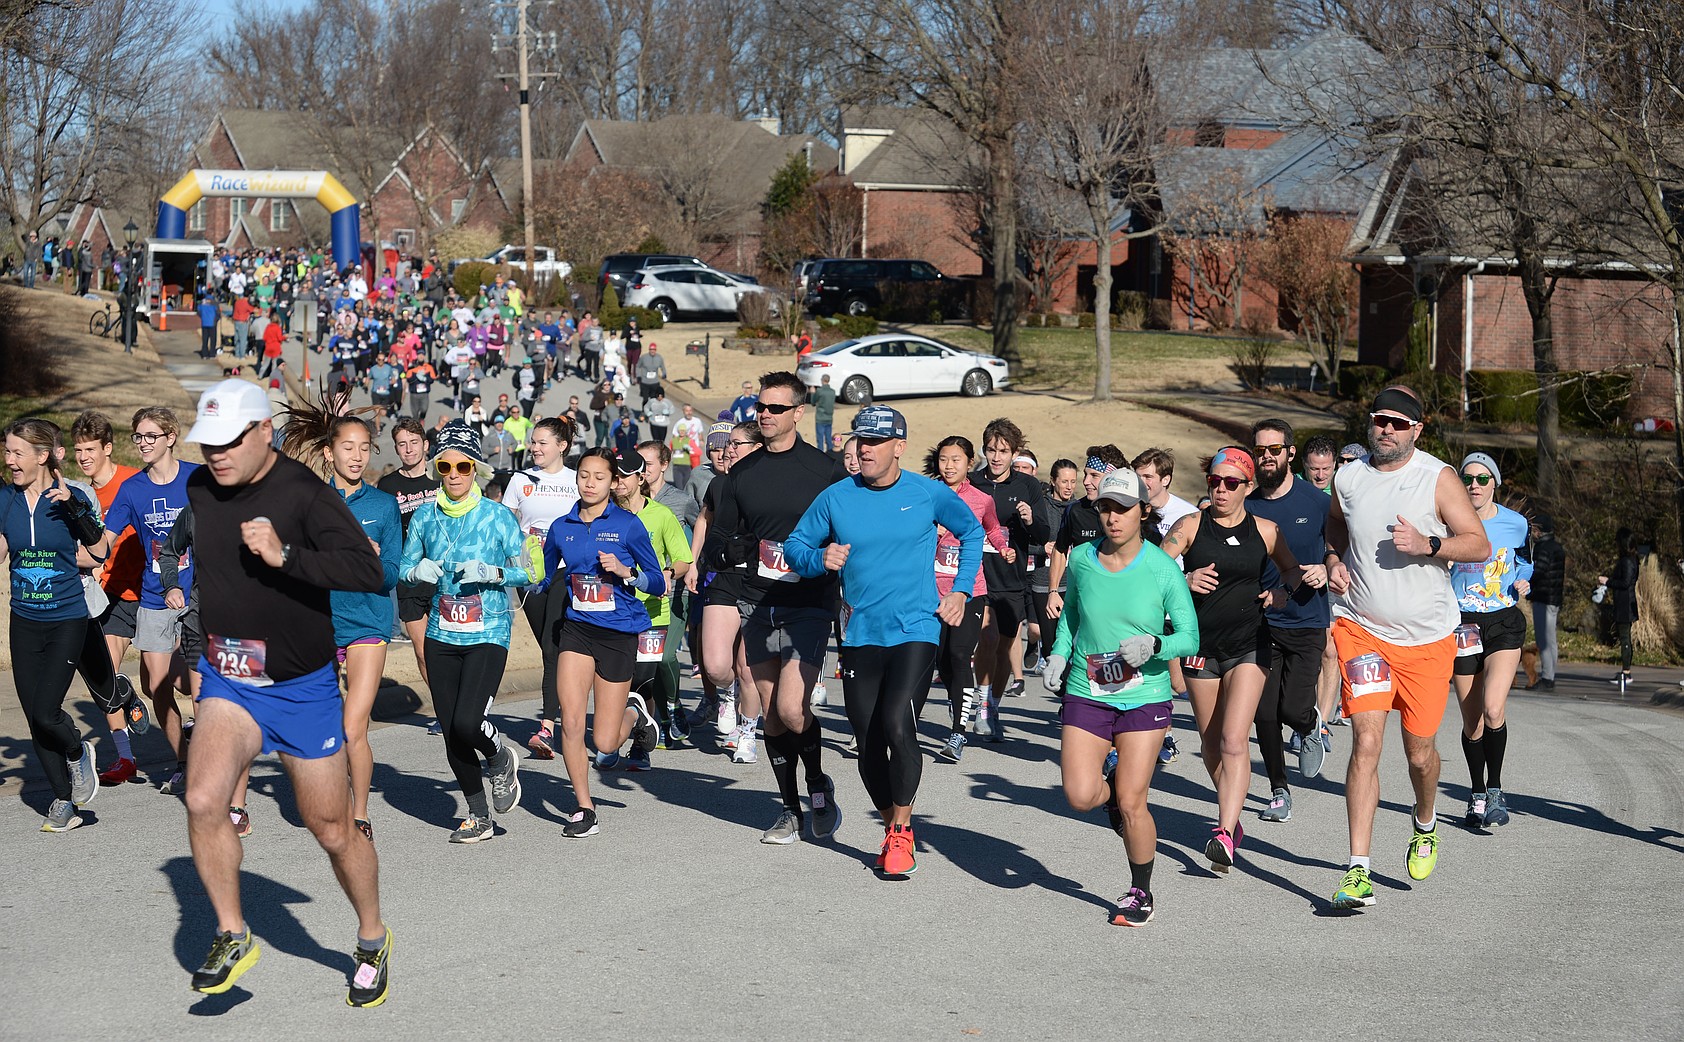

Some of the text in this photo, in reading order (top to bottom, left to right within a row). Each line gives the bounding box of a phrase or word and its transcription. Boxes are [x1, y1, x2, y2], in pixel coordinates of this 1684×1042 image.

[534, 484, 577, 495] HENDRIX
[18, 548, 57, 558] White River
[21, 558, 54, 568] Marathon
[31, 592, 53, 601] Kenya
[582, 584, 598, 601] 71
[451, 604, 468, 622] 68
[646, 638, 660, 653] 89
[217, 651, 252, 676] 236
[1102, 662, 1124, 683] 80
[1363, 662, 1382, 682] 62
